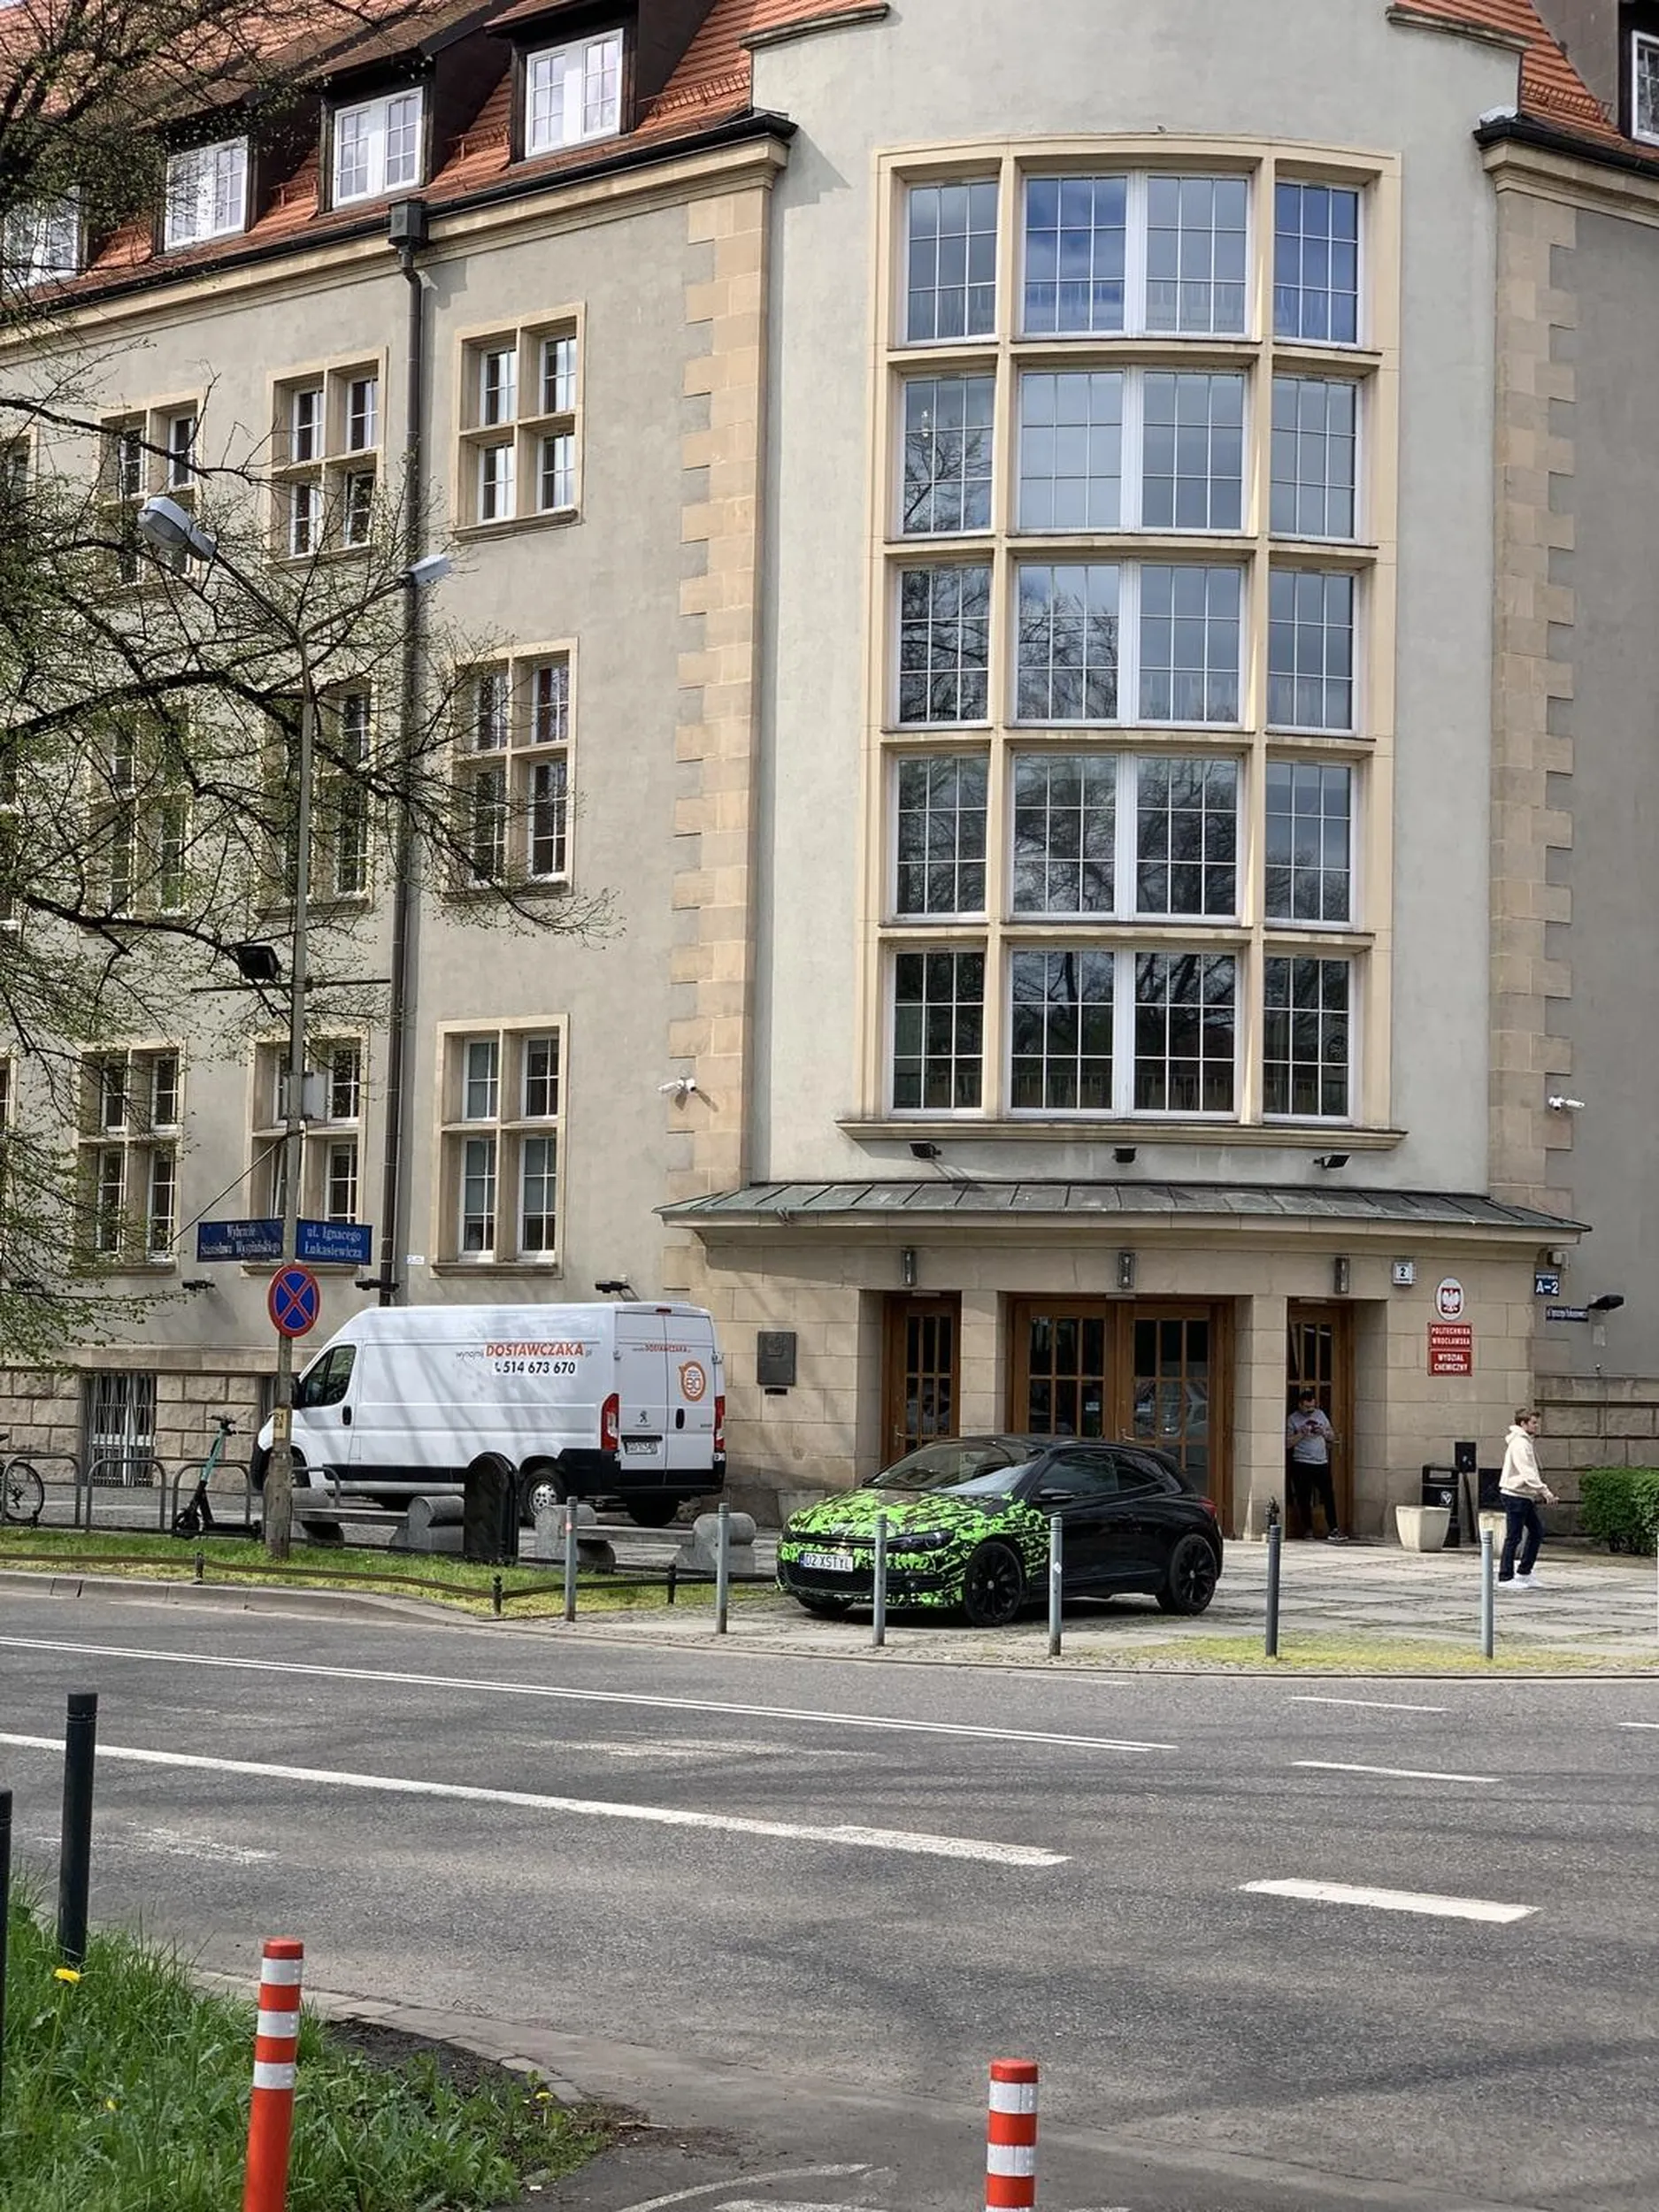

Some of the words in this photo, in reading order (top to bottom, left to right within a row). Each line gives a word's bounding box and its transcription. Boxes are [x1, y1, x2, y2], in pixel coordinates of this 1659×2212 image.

[306, 1225, 319, 1238] ul.
[322, 1225, 362, 1243] Ignacego
[304, 1240, 363, 1258] Łukasiewicza
[1400, 1267, 1406, 1277] 2
[1536, 1279, 1558, 1294] A-2
[503, 1361, 525, 1373] 514
[527, 1362, 549, 1374] 673
[553, 1362, 575, 1374] 670
[819, 1555, 850, 1571] XSTYL
